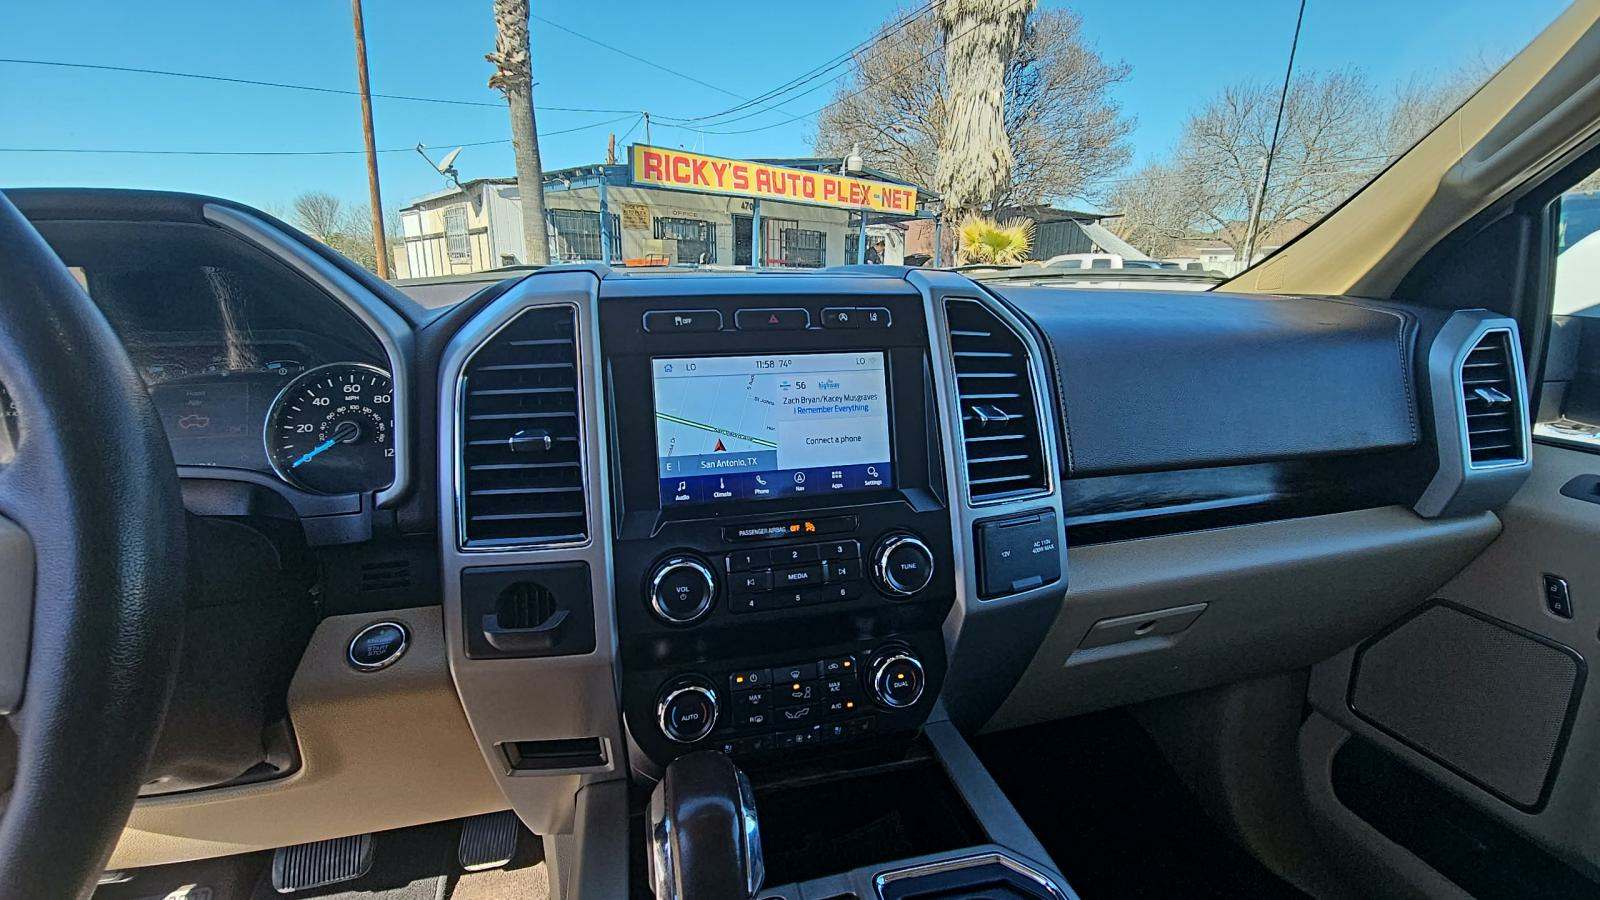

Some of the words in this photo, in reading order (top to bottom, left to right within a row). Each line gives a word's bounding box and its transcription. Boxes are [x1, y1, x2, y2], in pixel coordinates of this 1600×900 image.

[643, 151, 749, 190] RICKY'S
[755, 169, 816, 199] AUTO
[823, 178, 871, 206] PLEX
[881, 187, 912, 210] NET
[672, 210, 698, 218] OFFICE
[756, 360, 775, 369] 11:58
[856, 358, 866, 366] LO
[686, 363, 697, 372] LO
[343, 384, 361, 393] 60
[796, 381, 806, 390] 56
[312, 397, 330, 406] 40
[374, 395, 391, 404] 80
[783, 396, 800, 405] Zach
[843, 393, 878, 403] Musgraves
[797, 405, 834, 414] Remember
[834, 403, 869, 413] Everything
[297, 424, 313, 433] 20
[805, 436, 834, 446] Connect
[841, 435, 862, 445] phone
[666, 463, 672, 471] E
[701, 460, 716, 469] San
[716, 458, 747, 468] Antonio,
[747, 457, 758, 466] TX
[792, 551, 797, 559] 2
[900, 563, 917, 571] TUNE
[787, 572, 808, 580] MEDIA
[840, 588, 846, 596] 6
[795, 594, 801, 602] 5
[681, 713, 699, 721] AUTO
